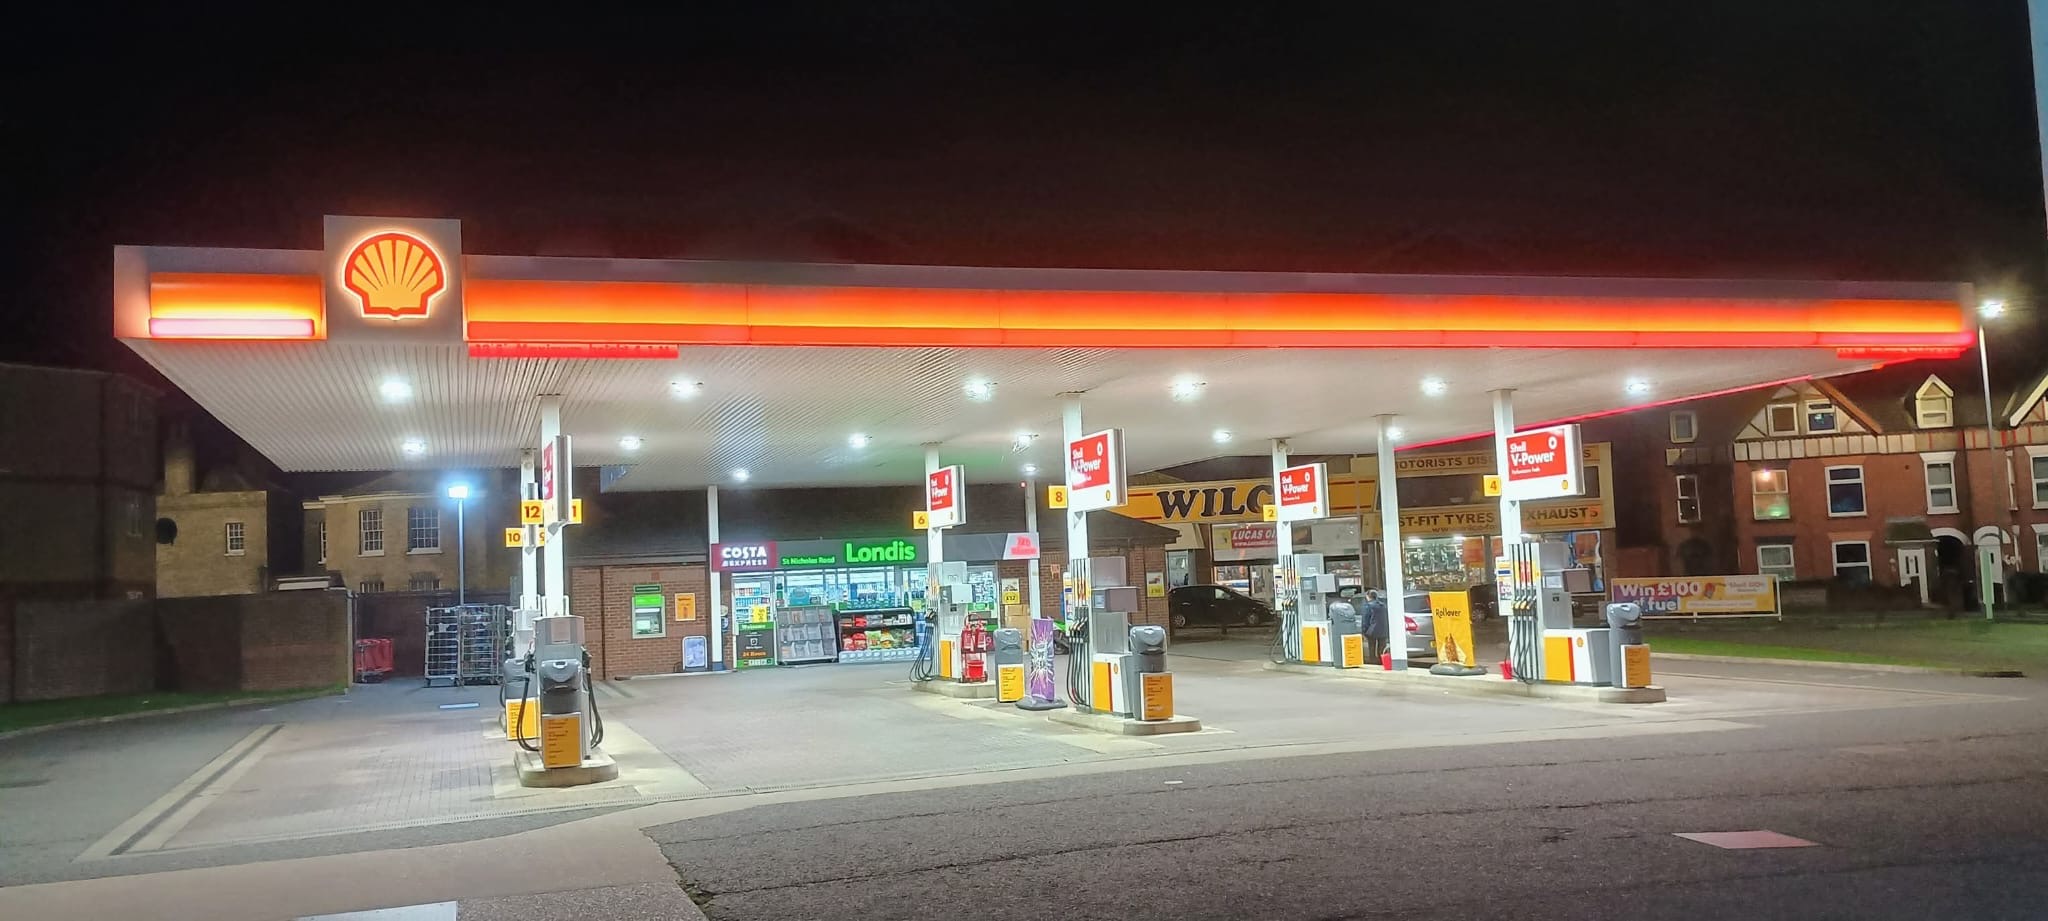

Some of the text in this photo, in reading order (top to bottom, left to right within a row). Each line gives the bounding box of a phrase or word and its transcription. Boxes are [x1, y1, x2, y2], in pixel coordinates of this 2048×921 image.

[1510, 441, 1526, 453] Shell
[1511, 451, 1555, 466] V-Power
[1283, 483, 1310, 495] V-Power
[1490, 480, 1498, 491] 4
[1056, 491, 1063, 503] 8
[1157, 484, 1273, 519] WILC
[524, 505, 540, 518] 12
[572, 505, 578, 518] 1
[1269, 509, 1275, 518] 2
[1526, 505, 1599, 520] XHAUSTS
[918, 515, 925, 525] 6
[1398, 514, 1442, 528] ST-FIT
[1445, 512, 1495, 525] TYRES
[507, 532, 521, 543] 10
[1232, 529, 1278, 541] LUCAS OI
[721, 546, 768, 559] COSTA
[846, 541, 916, 563] Londis
[729, 559, 768, 567] EXPRESS
[790, 557, 817, 565] Nicholas
[818, 556, 835, 564] Road
[1620, 581, 1702, 598] Win £100
[1648, 597, 1681, 612] fuel
[1435, 607, 1461, 619] Rollover
